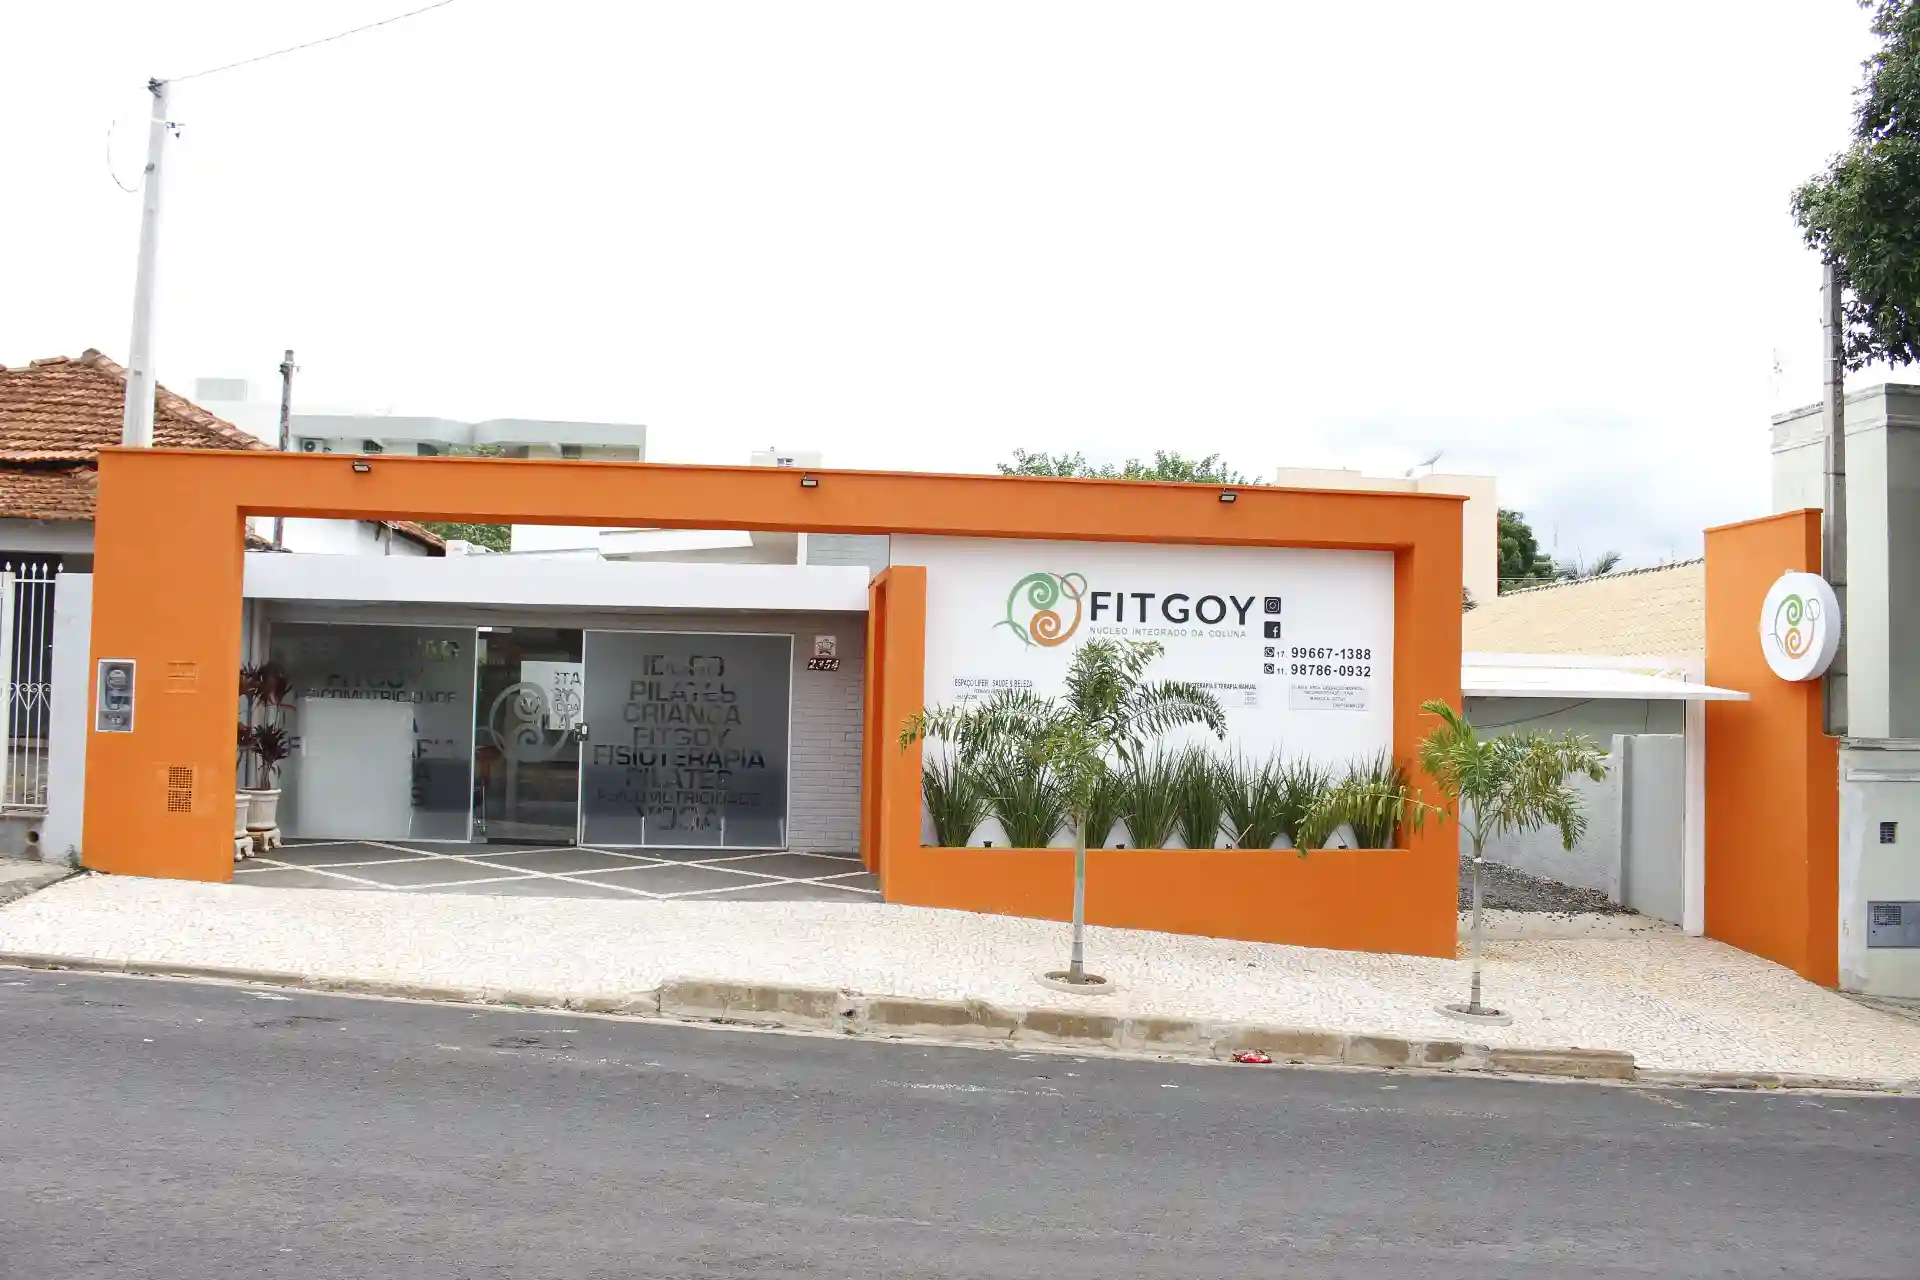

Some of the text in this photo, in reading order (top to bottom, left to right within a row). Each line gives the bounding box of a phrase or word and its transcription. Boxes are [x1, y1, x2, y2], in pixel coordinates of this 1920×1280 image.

[1091, 592, 1256, 625] FITGOY
[1132, 627, 1188, 637] INTEGRADO
[1192, 629, 1204, 638] DA
[1208, 630, 1247, 639] COLUNA
[1291, 647, 1371, 660] 99667-1388
[1291, 664, 1371, 677] 98786-0932
[592, 744, 766, 769] FISIOTERAPIA
